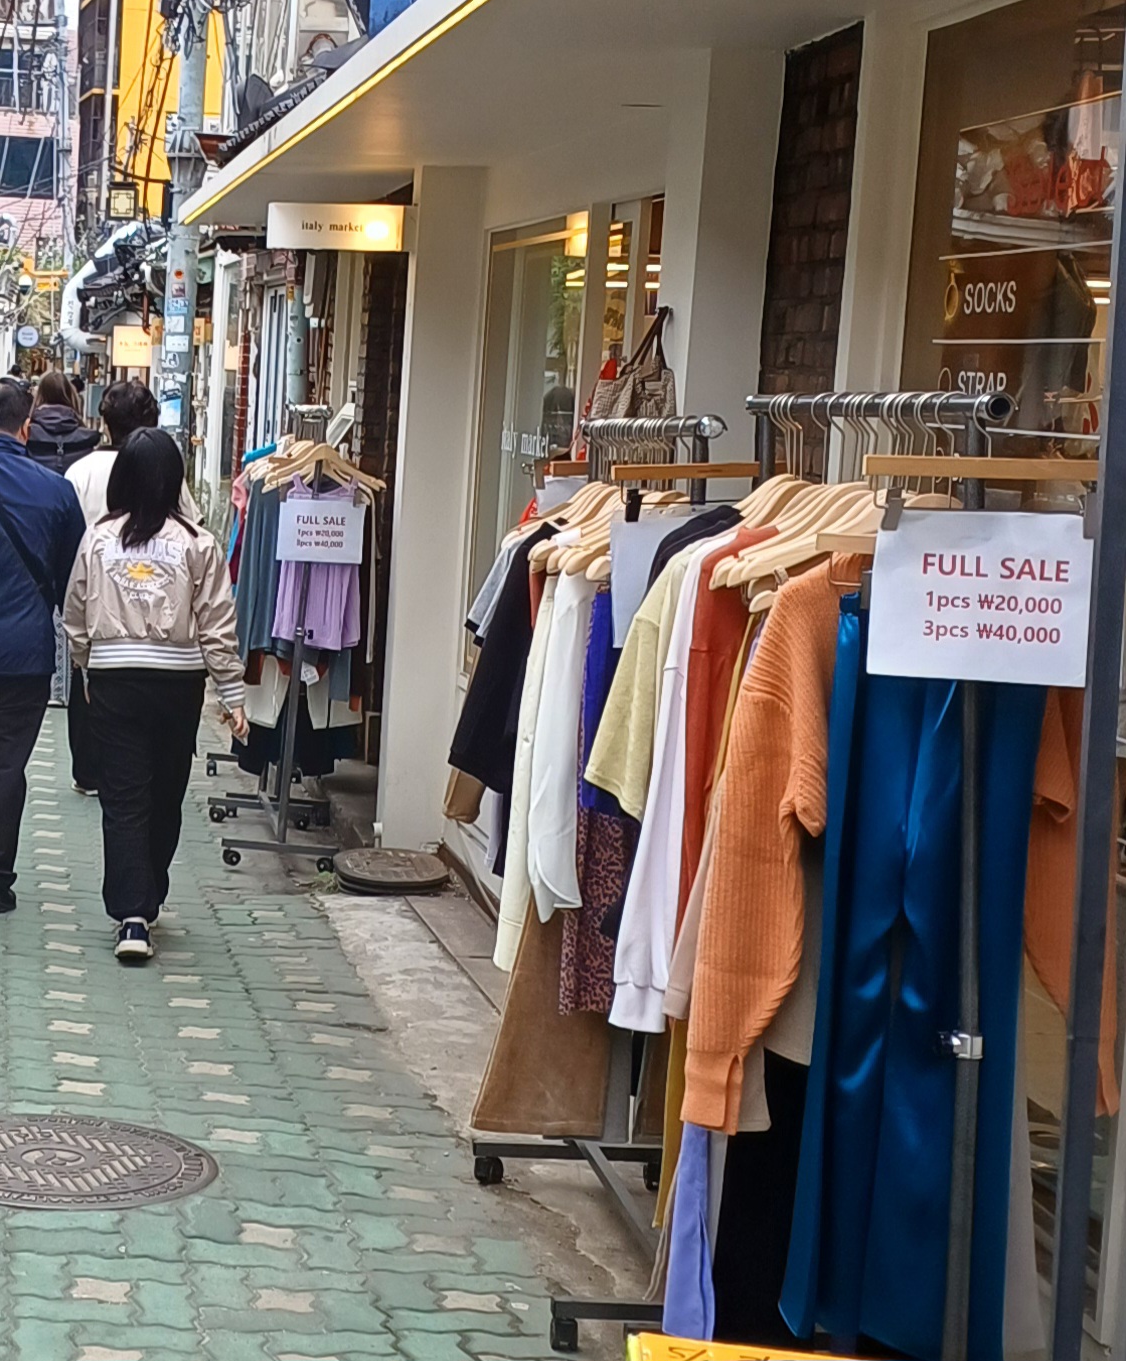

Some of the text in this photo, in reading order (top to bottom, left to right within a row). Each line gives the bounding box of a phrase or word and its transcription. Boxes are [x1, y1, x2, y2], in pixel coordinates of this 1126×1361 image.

[302, 220, 323, 232] italy
[964, 280, 1017, 314] SOCKS
[958, 370, 1007, 395] STRAP
[296, 514, 346, 526] FULL SALE
[922, 553, 1070, 582] FULL SALE
[925, 591, 1063, 616] 1pcs ₩20,000
[923, 620, 1061, 644] 3pcs ₩40,000
